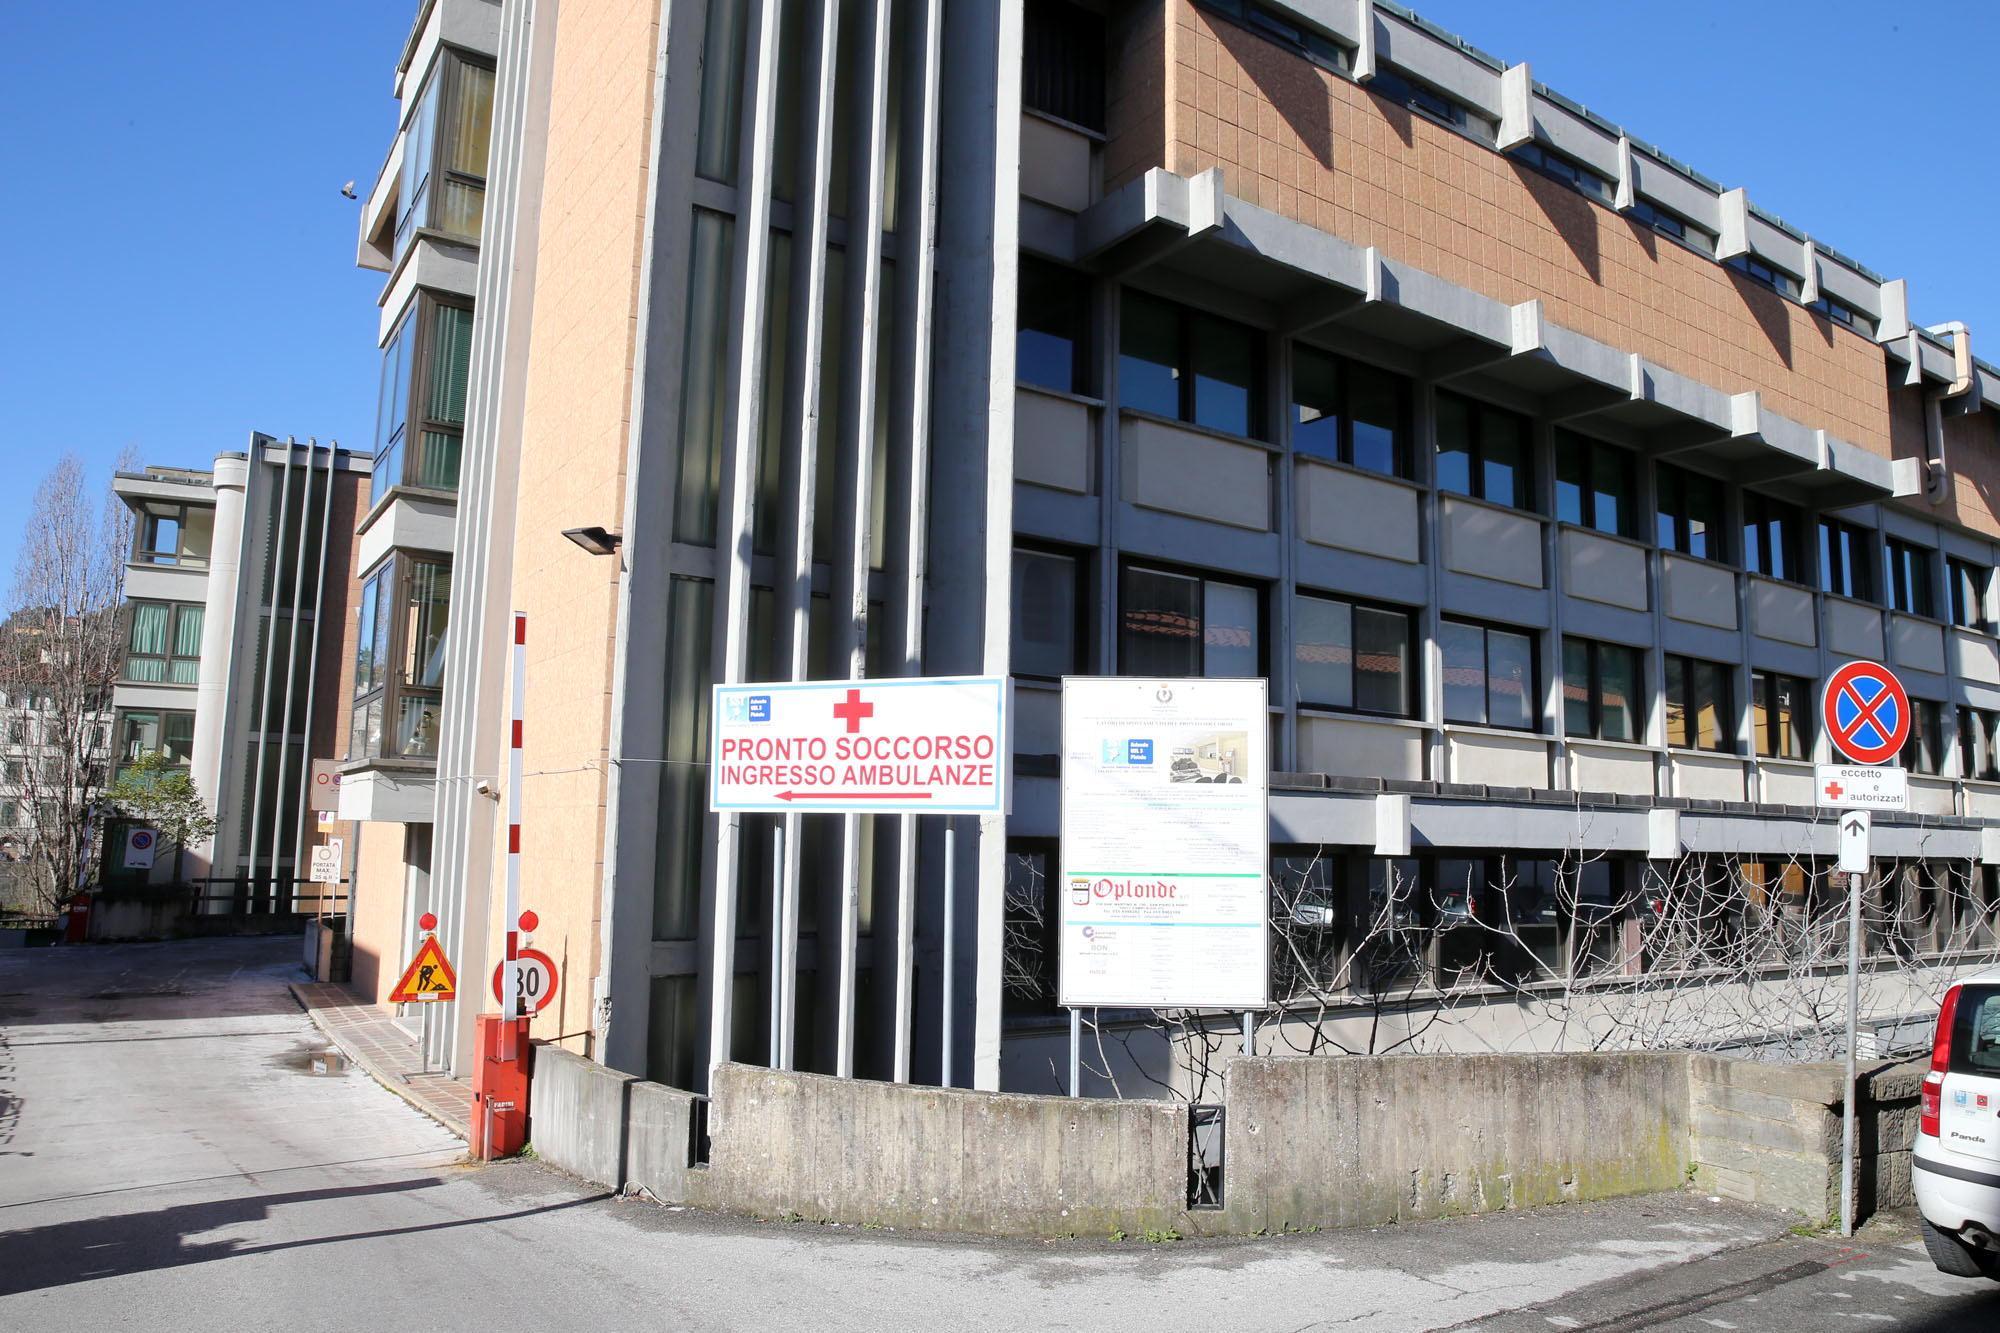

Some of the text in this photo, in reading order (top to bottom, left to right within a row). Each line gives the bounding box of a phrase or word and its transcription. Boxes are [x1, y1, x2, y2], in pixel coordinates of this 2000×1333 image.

[721, 735, 994, 761] PRONTO SOCCORSO
[721, 765, 994, 785] INGRESSO AMBULANZE
[1841, 769, 1882, 778] eccetto
[1850, 793, 1904, 803] autorizzati
[1093, 879, 1177, 900] Oplonde
[1951, 1131, 1985, 1143] Panda
